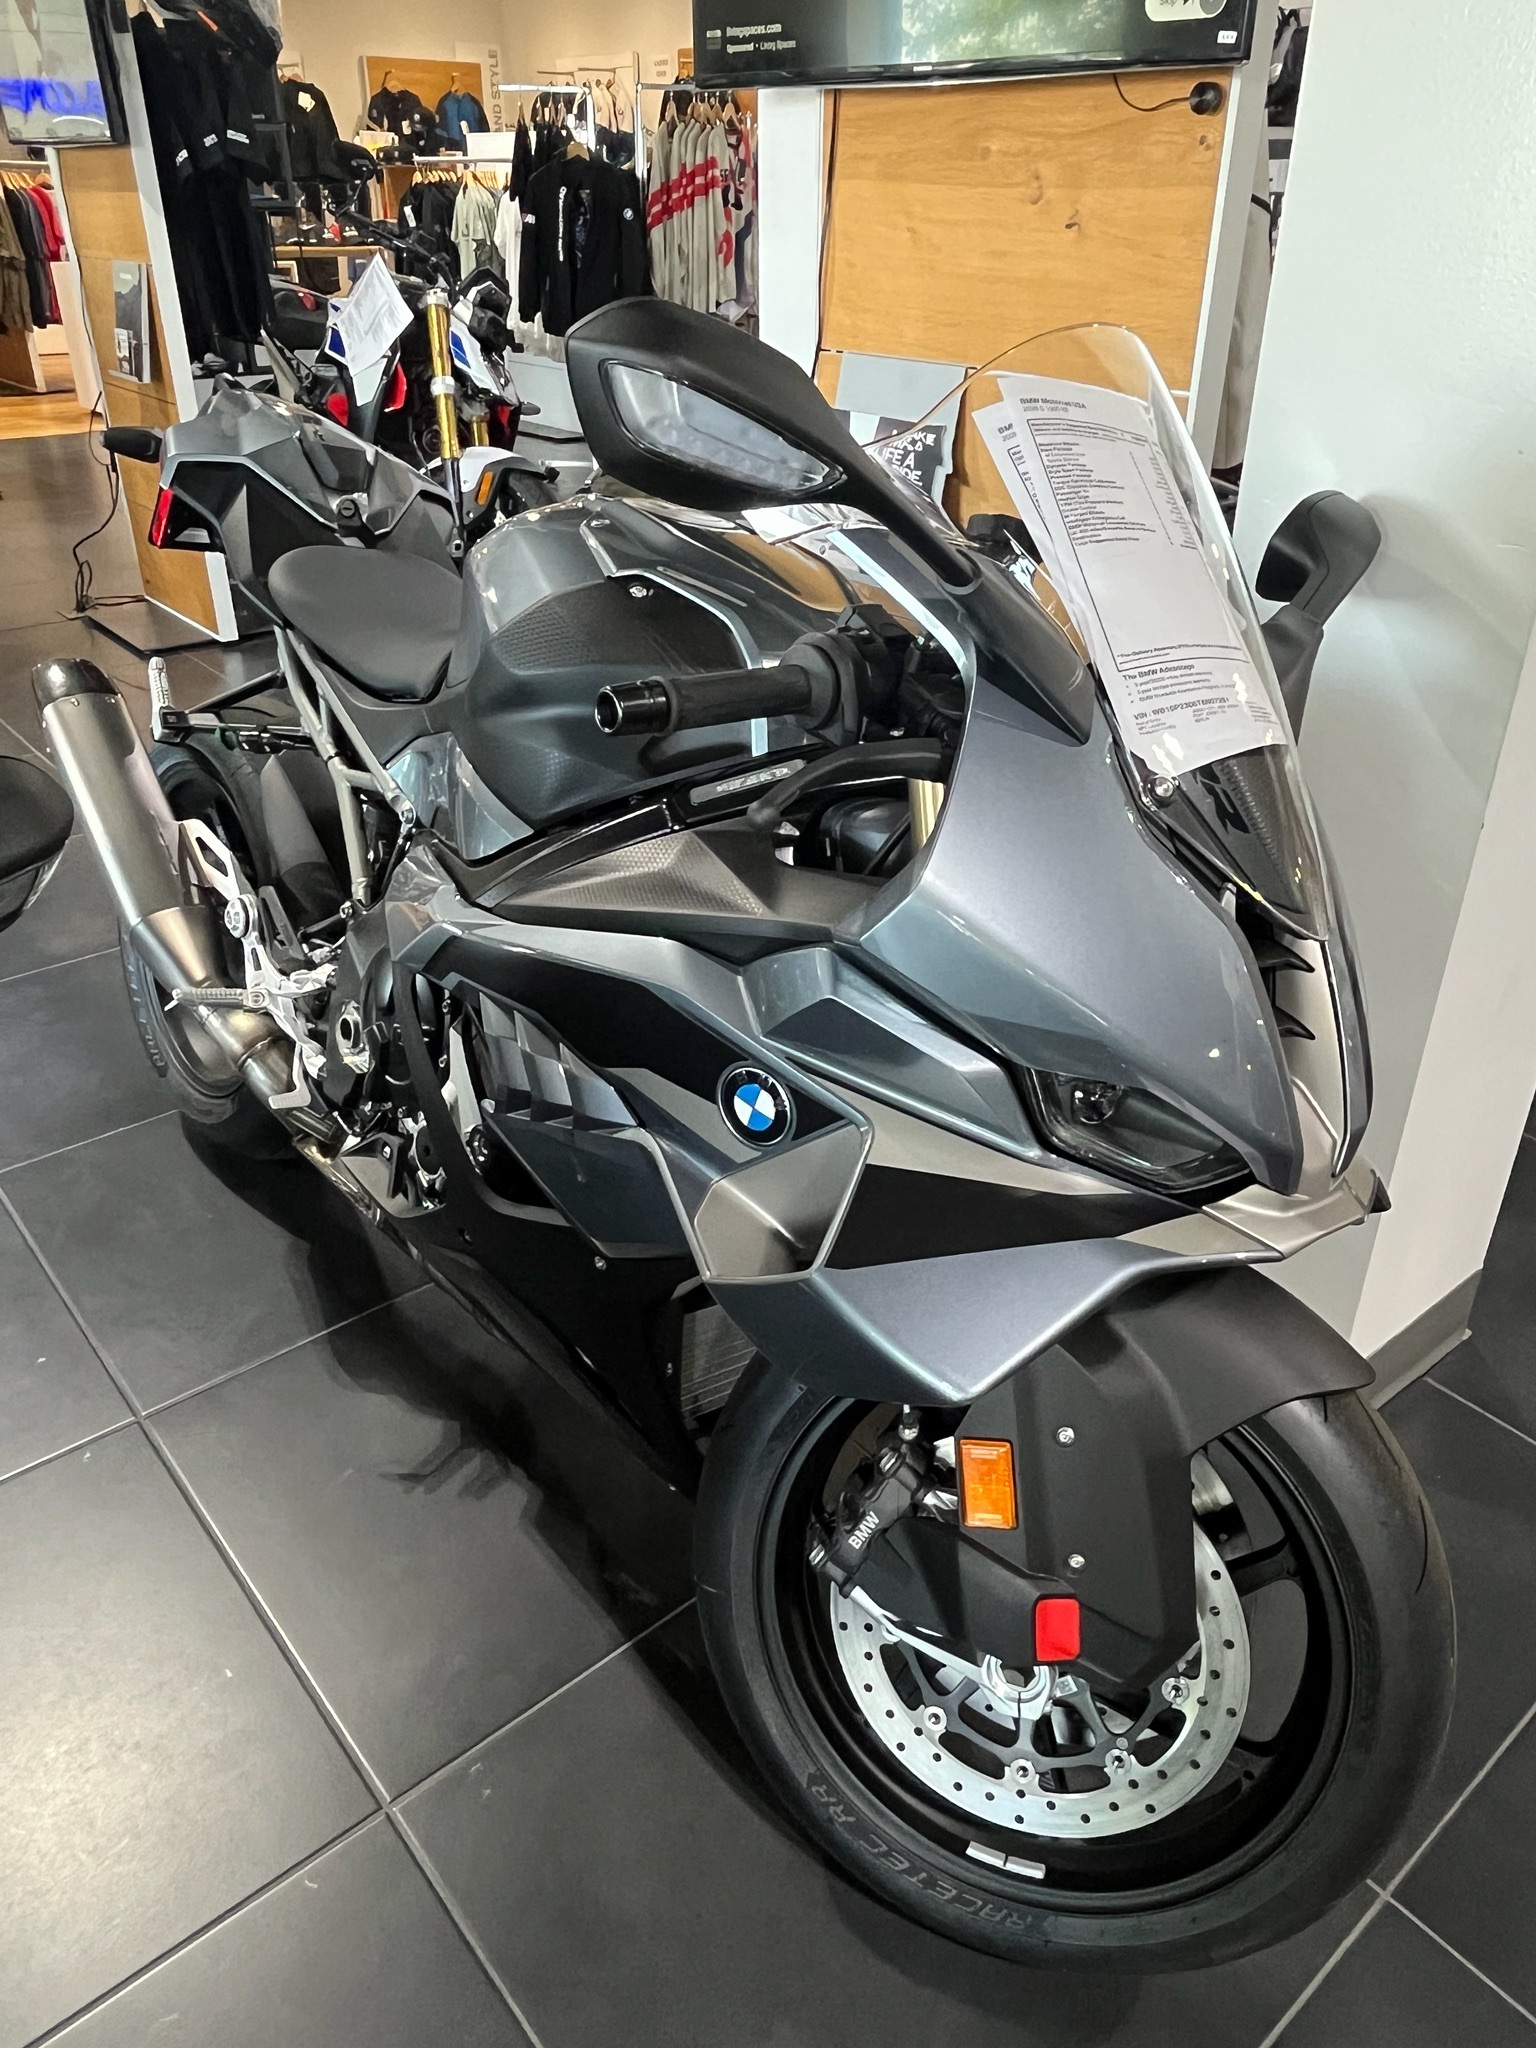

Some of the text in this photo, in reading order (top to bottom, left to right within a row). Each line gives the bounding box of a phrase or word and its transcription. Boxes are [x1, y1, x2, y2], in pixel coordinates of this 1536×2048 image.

[903, 451, 915, 470] A
[848, 1511, 880, 1550] BMW
[810, 1784, 1033, 1929] RACETEC RR
